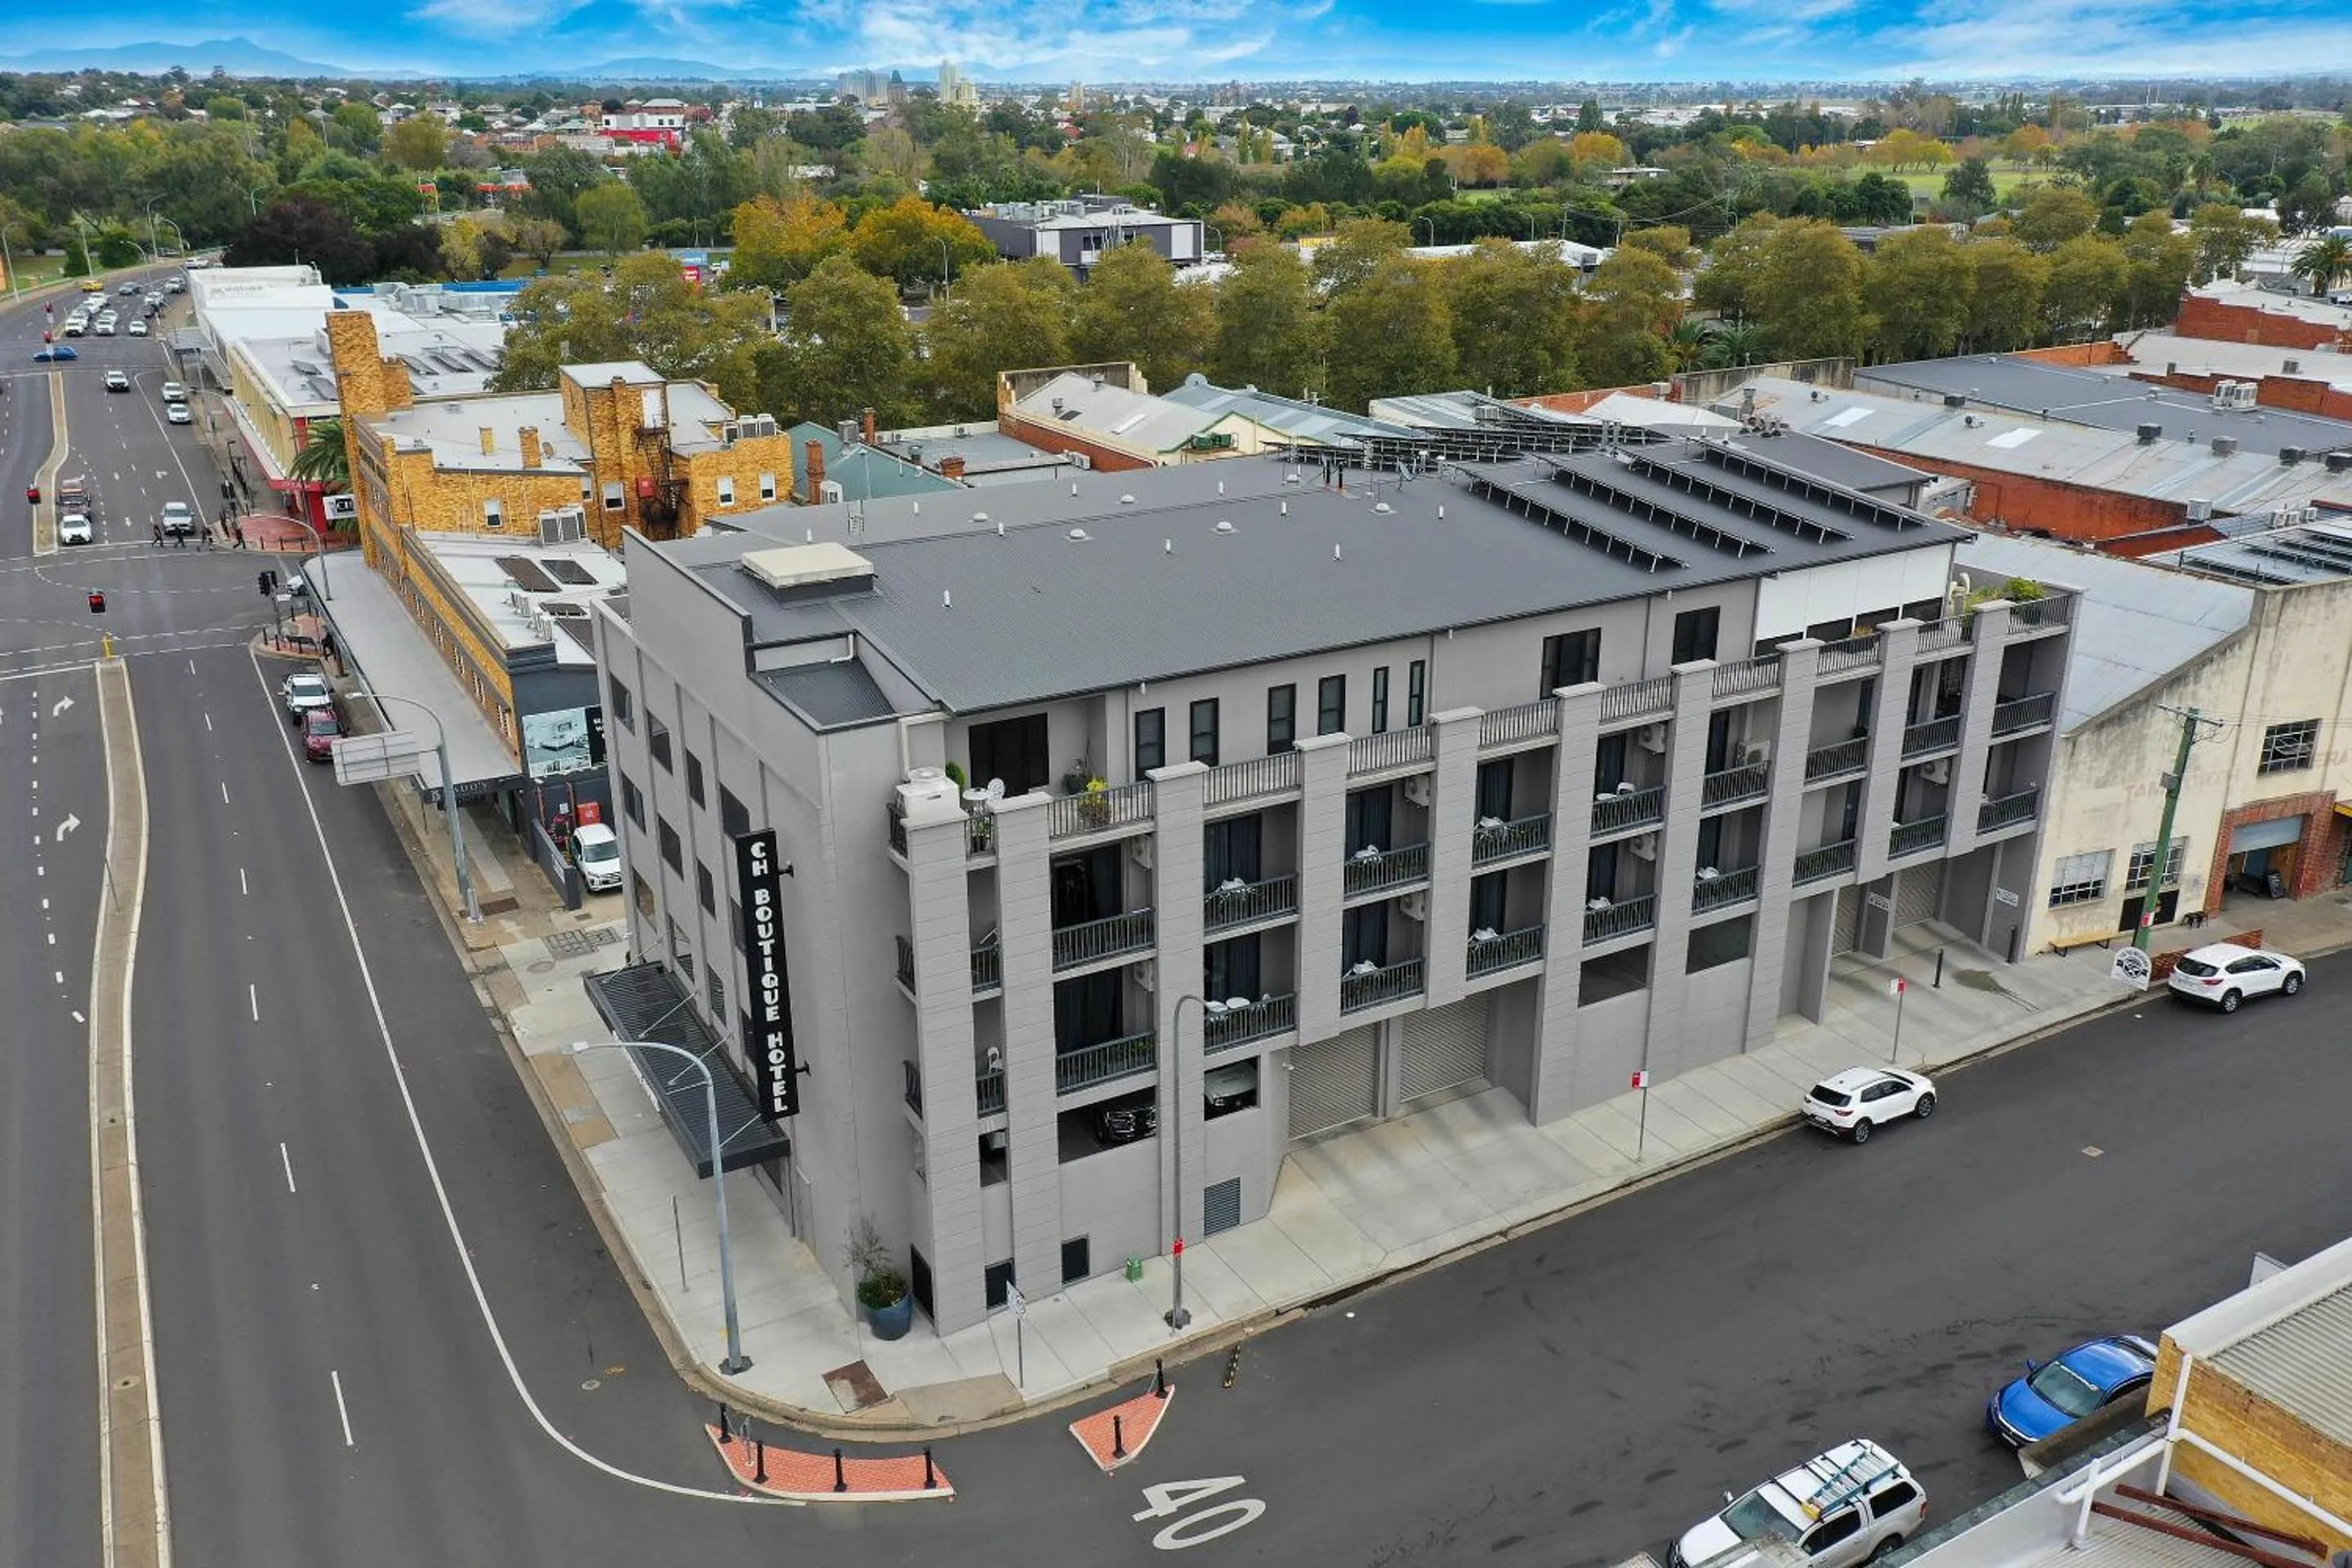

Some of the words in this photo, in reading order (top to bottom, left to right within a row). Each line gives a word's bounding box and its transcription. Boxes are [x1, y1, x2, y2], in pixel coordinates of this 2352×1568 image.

[750, 841, 768, 877] CH
[754, 888, 781, 1022] BOUTIQUE
[767, 1031, 788, 1113] HOTEL
[1132, 1475, 1266, 1550] 40
